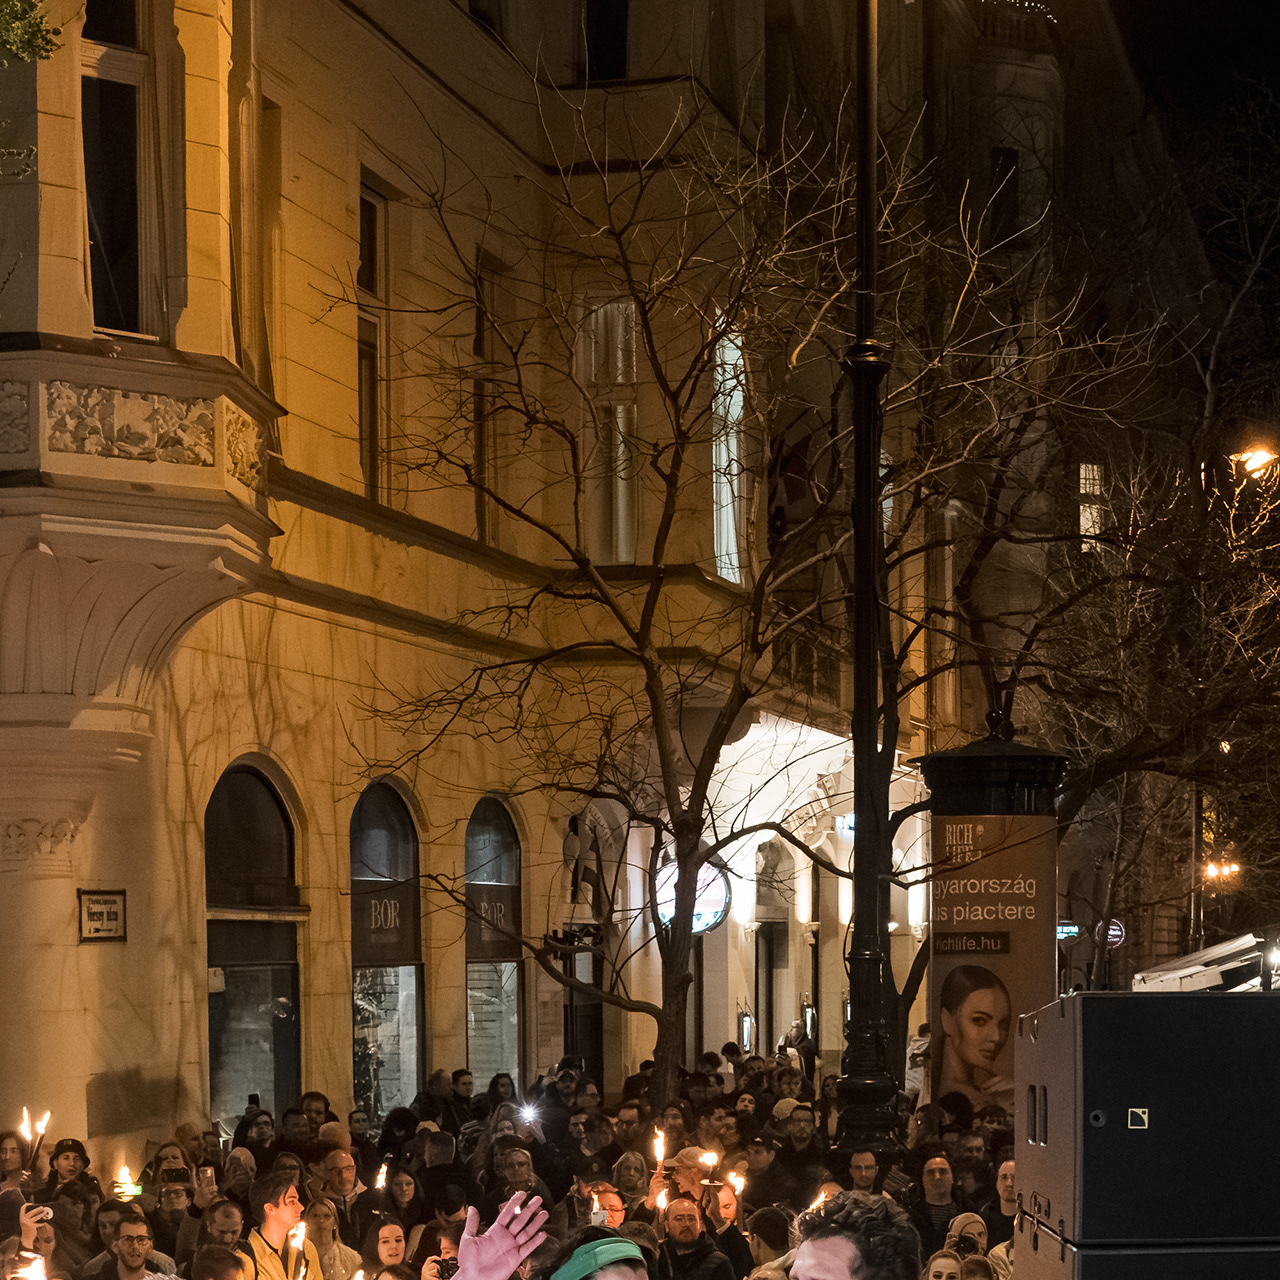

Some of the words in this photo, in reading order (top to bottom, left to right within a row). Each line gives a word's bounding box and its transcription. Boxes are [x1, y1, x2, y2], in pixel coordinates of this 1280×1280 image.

[945, 823, 973, 846] RICH
[370, 899, 400, 929] BOR
[953, 902, 1036, 925] piactere
